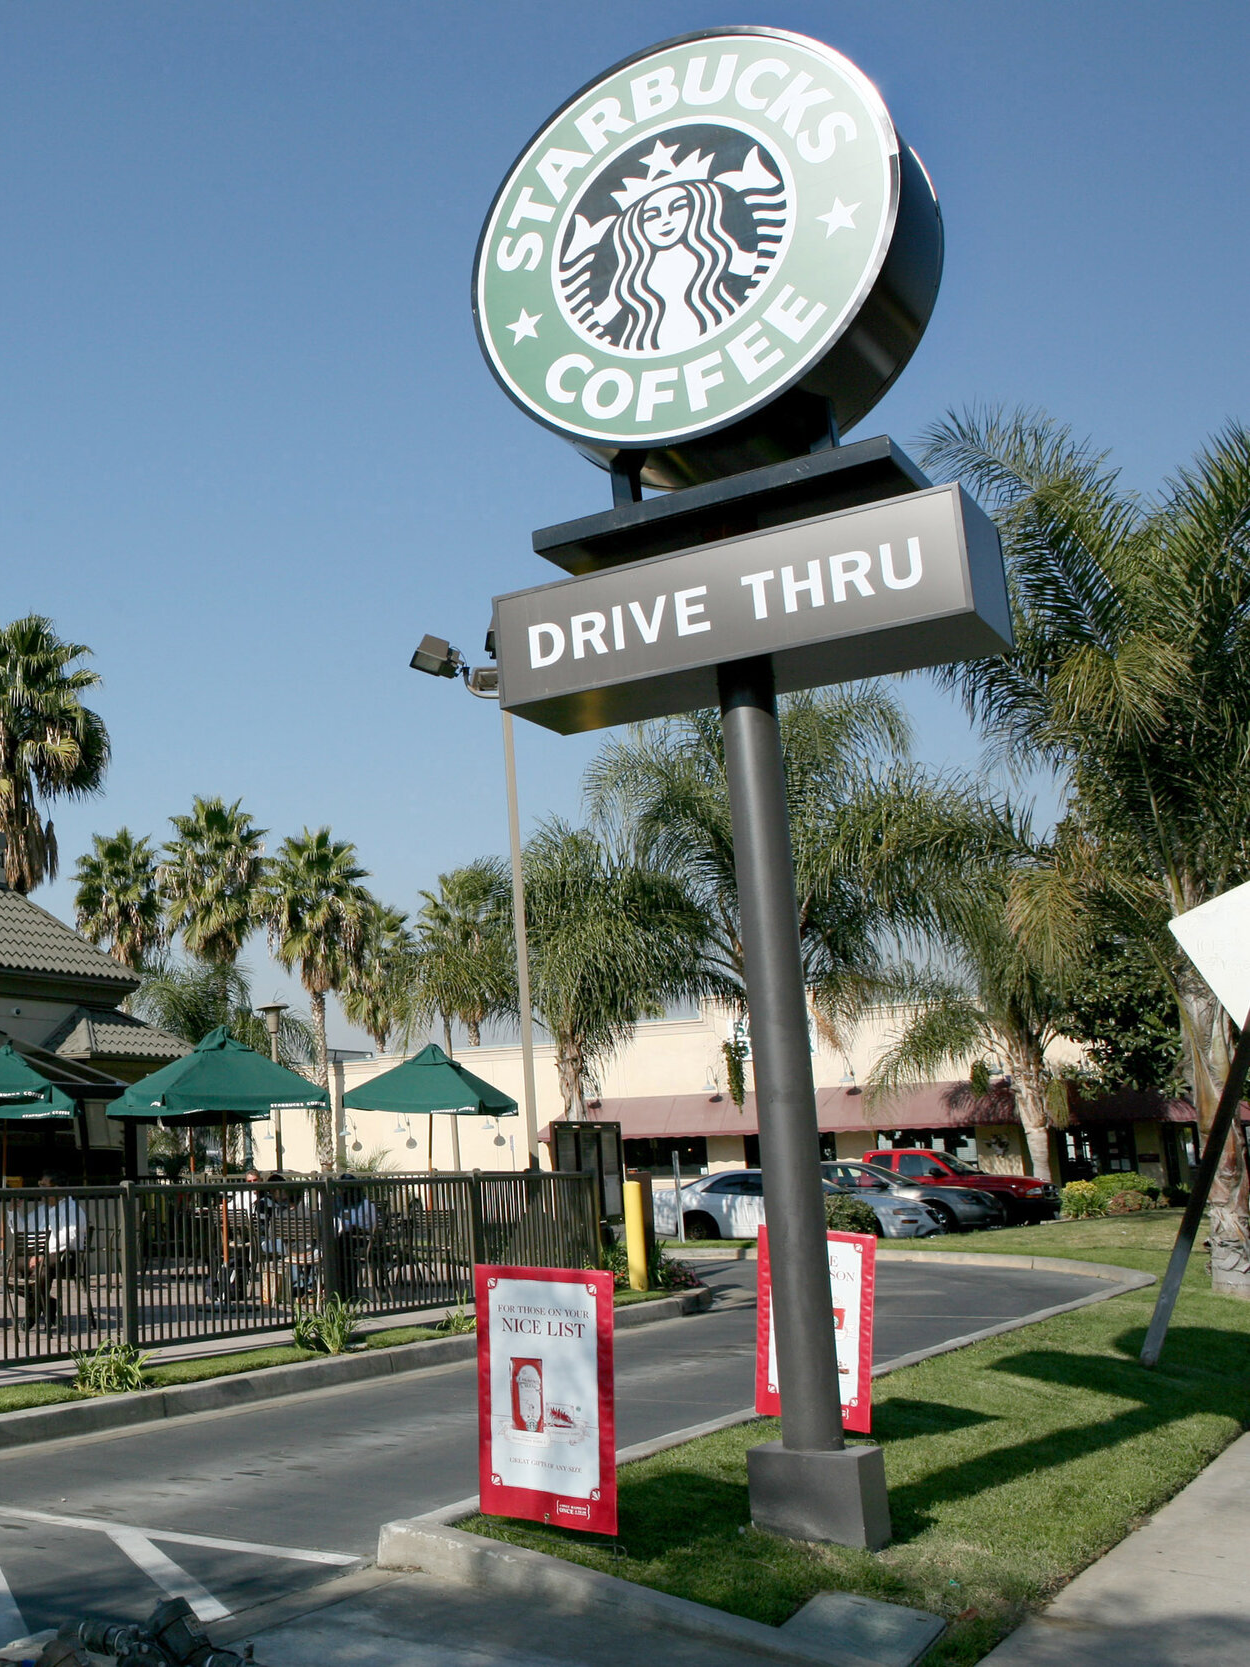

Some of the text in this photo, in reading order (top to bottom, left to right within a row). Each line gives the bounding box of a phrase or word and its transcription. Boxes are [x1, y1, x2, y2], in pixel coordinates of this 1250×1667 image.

[496, 54, 857, 272] STARBUCKS
[545, 284, 828, 422] COFFEE
[528, 536, 923, 669] DRIVE THRU
[498, 1305, 589, 1319] FOR THOSE ON YOUR
[502, 1317, 585, 1338] NICE LIST
